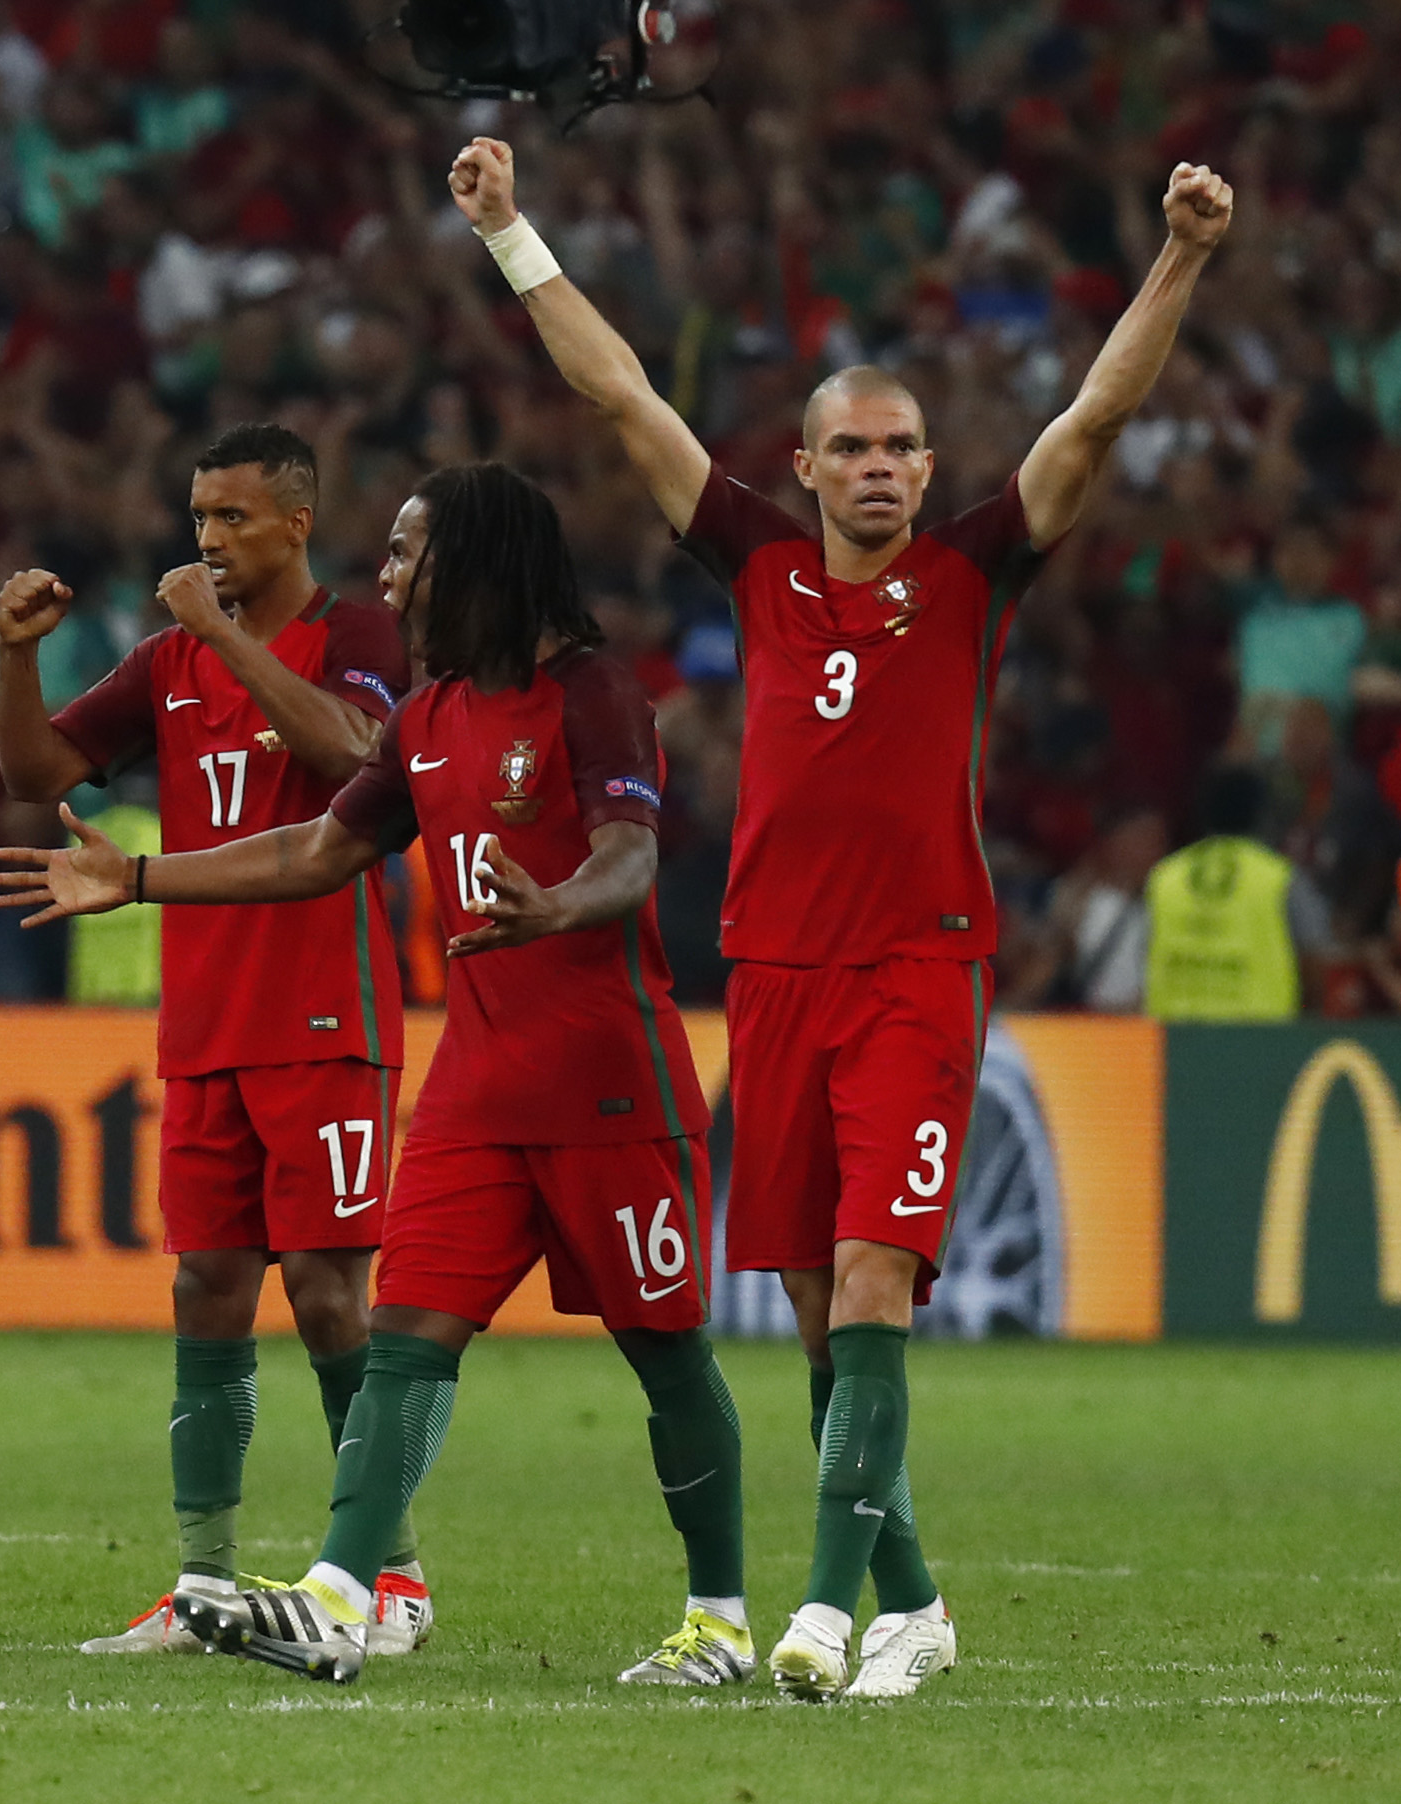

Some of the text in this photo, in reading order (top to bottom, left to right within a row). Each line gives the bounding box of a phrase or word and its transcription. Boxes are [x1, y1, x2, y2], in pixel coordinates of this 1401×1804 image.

[814, 650, 857, 720] 3
[198, 750, 248, 827] 17
[449, 833, 498, 911] 16
[318, 1119, 374, 1196] 17
[907, 1120, 948, 1197] 3
[615, 1198, 685, 1278] 16
